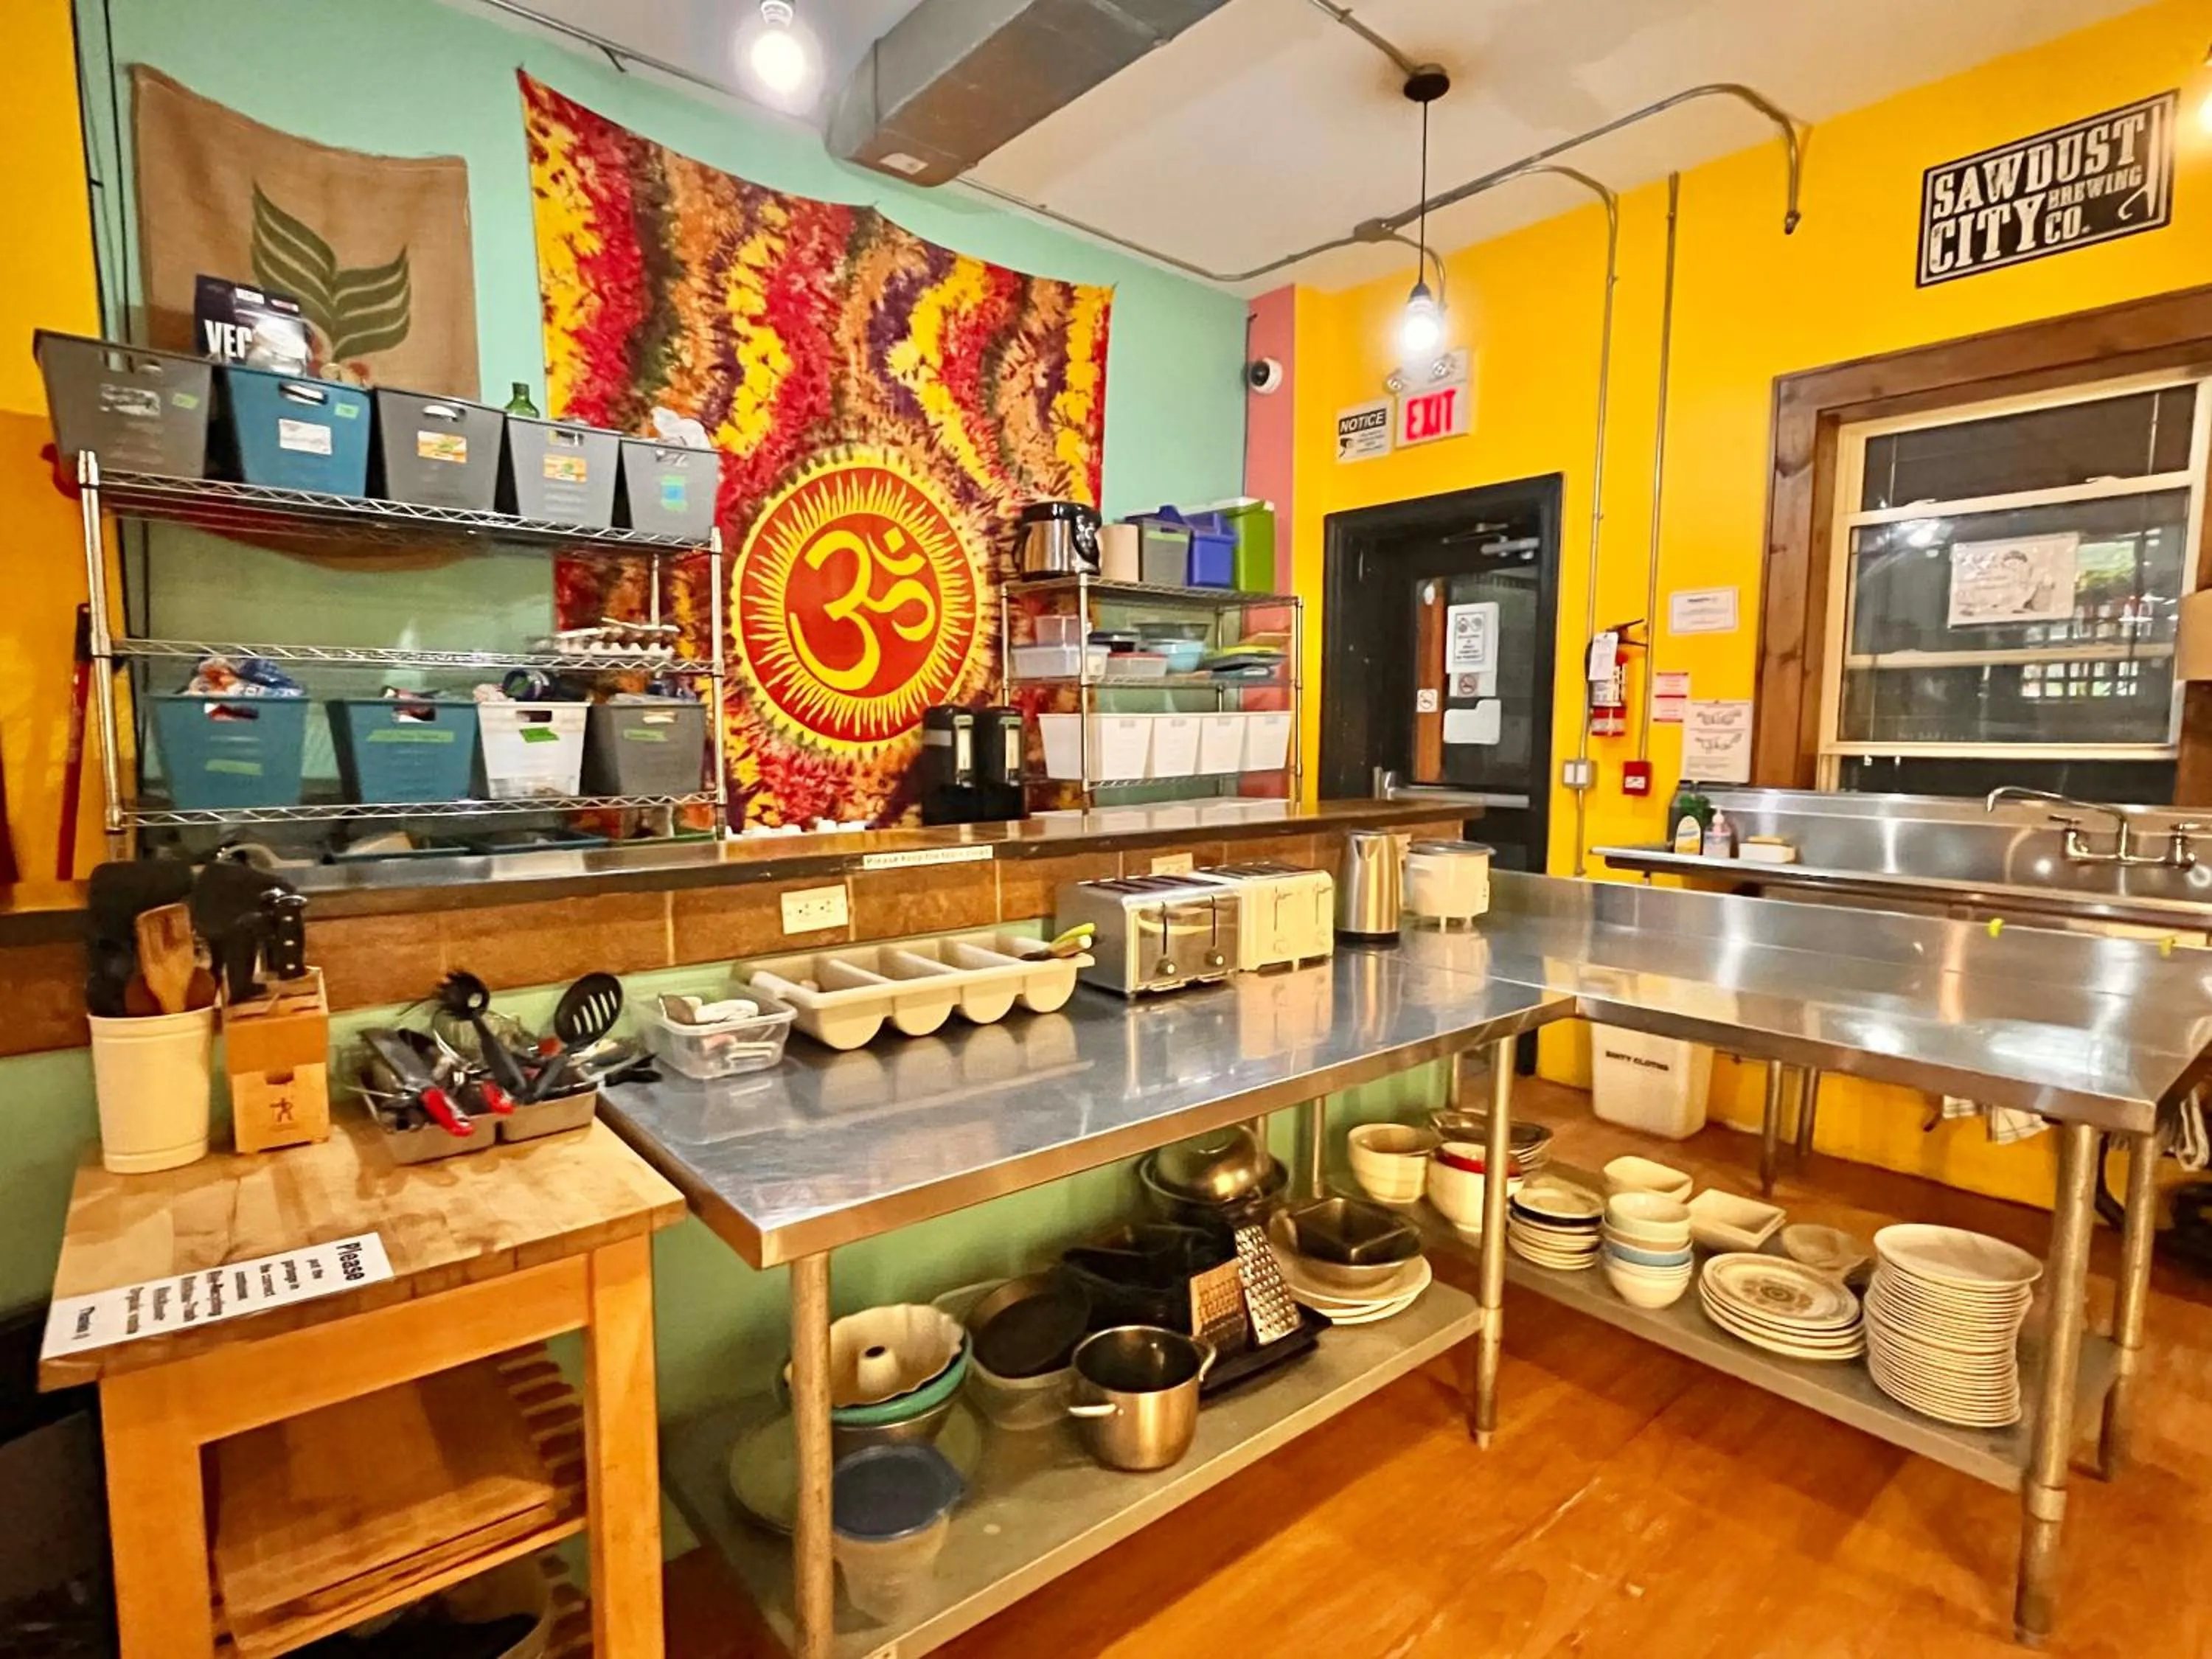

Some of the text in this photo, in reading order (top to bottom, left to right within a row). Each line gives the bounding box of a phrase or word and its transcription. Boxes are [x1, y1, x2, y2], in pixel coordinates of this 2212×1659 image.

[1933, 112, 2146, 219] SAWDUST
[2048, 164, 2143, 212] BREWING
[1928, 193, 2046, 274] CITY
[2044, 205, 2090, 245] CO.
[1340, 411, 1384, 433] NOTICE
[1407, 389, 1455, 440] EXIT
[335, 1242, 366, 1281] Please
